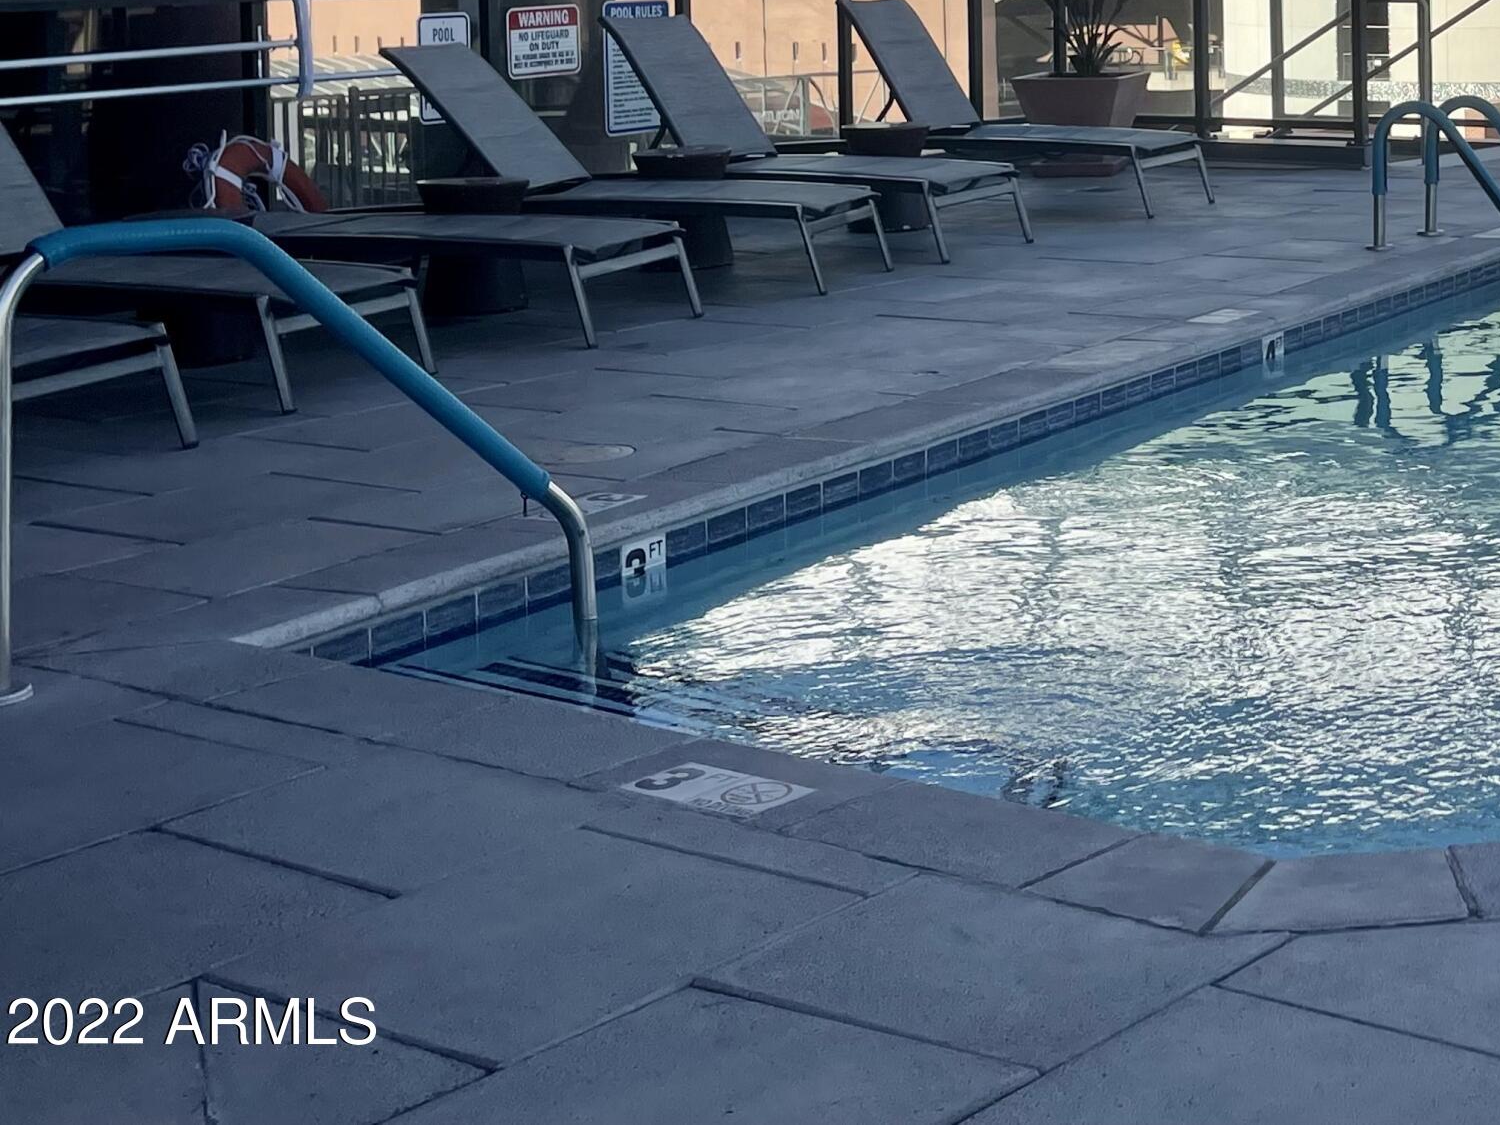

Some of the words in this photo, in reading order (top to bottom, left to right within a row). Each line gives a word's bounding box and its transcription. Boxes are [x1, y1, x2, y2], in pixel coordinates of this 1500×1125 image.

[517, 9, 569, 27] WARNING
[610, 6, 634, 19] POOL
[634, 4, 663, 19] RULES
[432, 27, 455, 42] POOL
[518, 32, 530, 42] NO
[530, 28, 570, 41] LIFEGUARD
[528, 42, 540, 51] ON
[541, 40, 560, 51] DUTY
[648, 539, 664, 558] FT
[634, 767, 707, 791] 3
